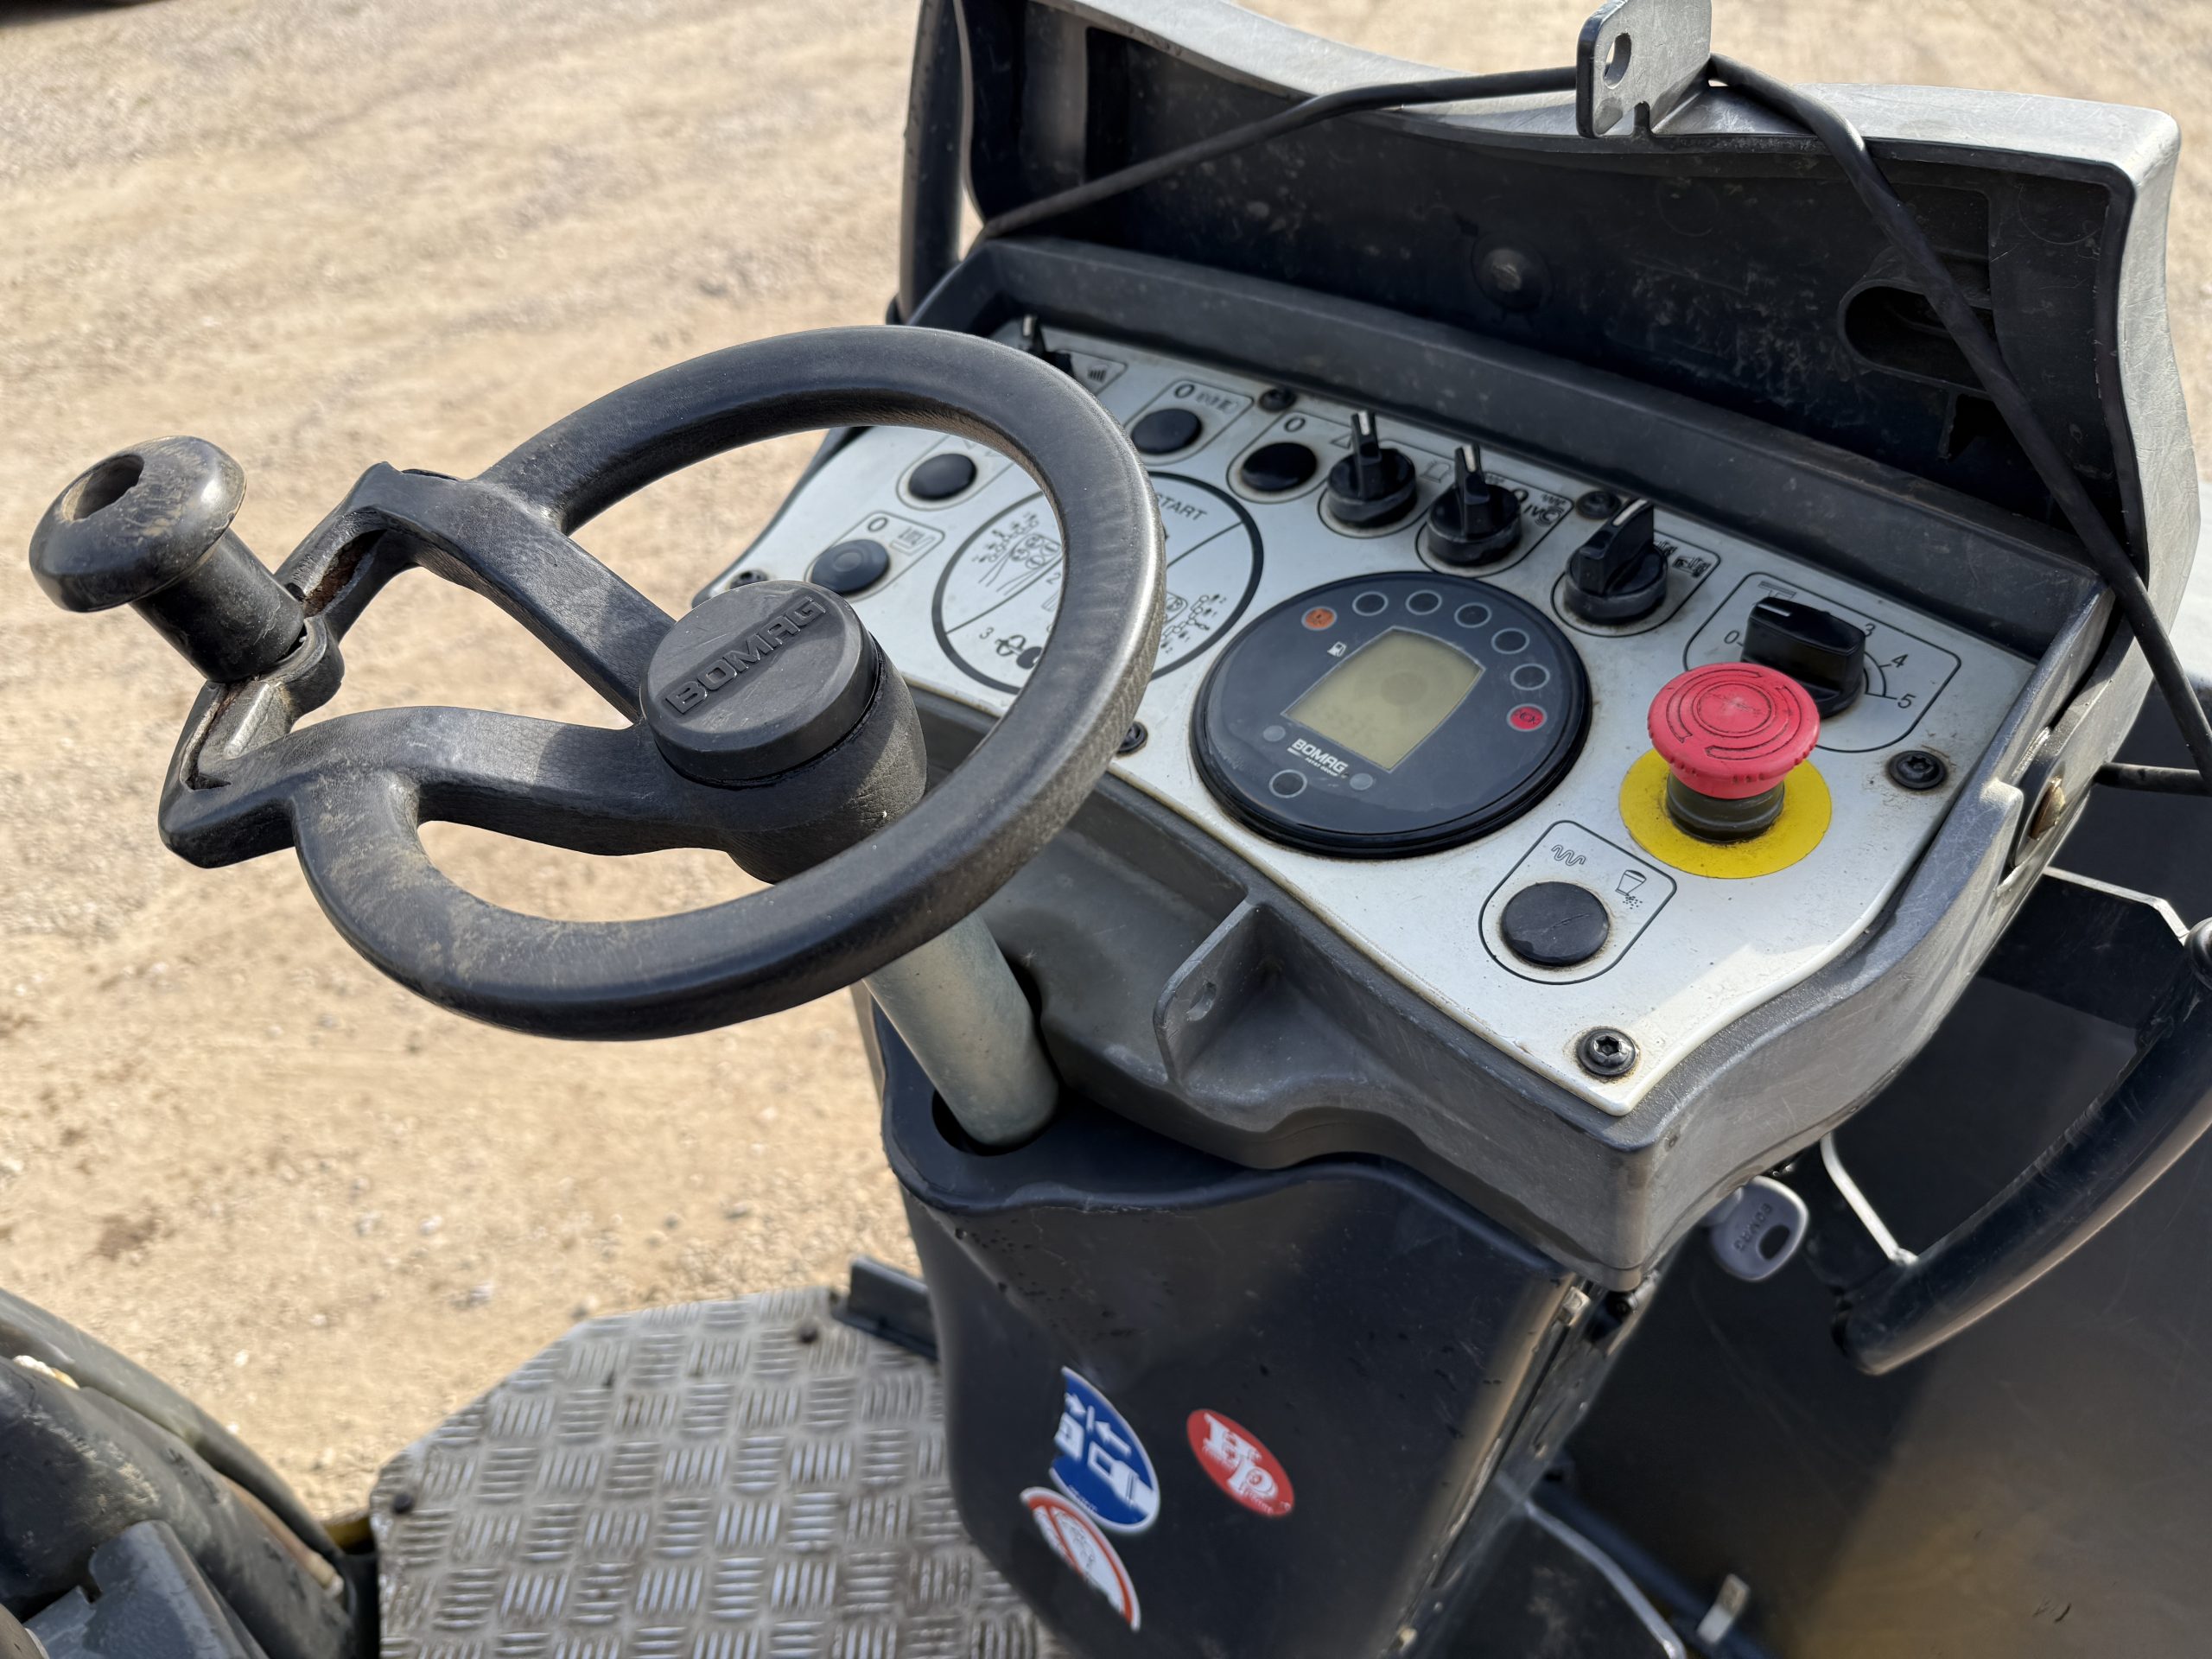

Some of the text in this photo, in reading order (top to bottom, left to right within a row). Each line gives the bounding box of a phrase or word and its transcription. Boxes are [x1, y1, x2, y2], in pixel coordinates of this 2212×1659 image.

[979, 627, 994, 639] 3
[1864, 623, 1877, 639] 3
[664, 596, 827, 714] BOMAG
[1891, 654, 1909, 669] 4
[1897, 694, 1916, 709] 5
[1292, 739, 1349, 773] BOMAG
